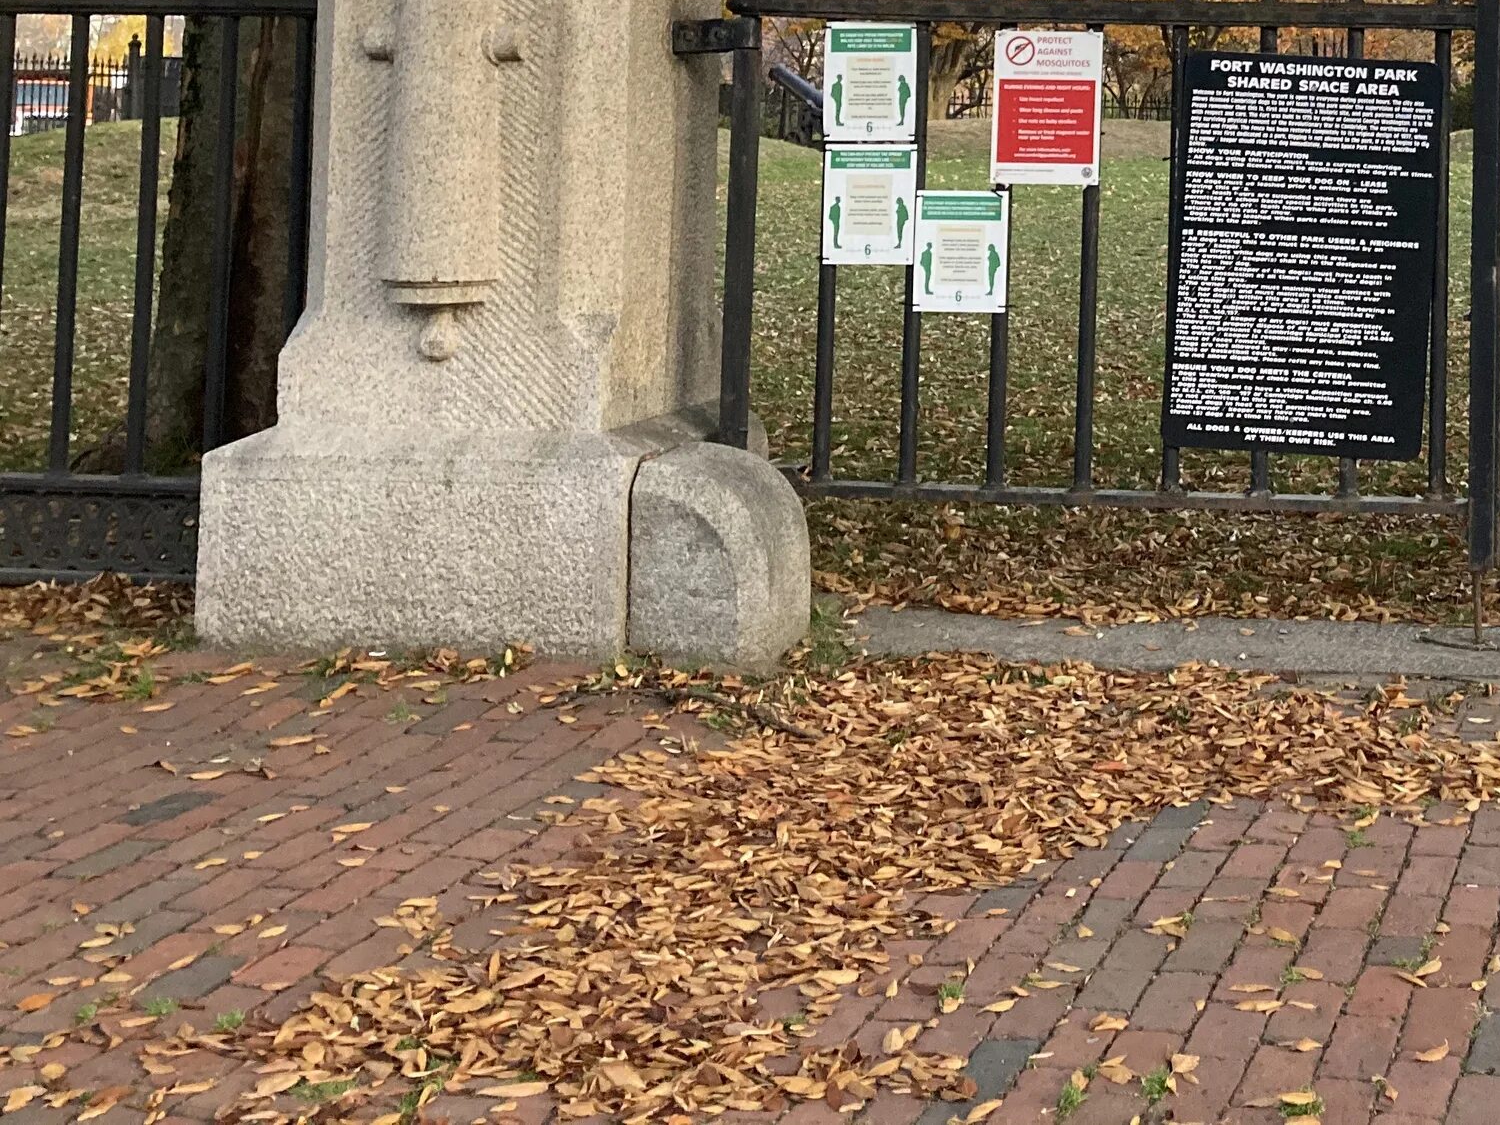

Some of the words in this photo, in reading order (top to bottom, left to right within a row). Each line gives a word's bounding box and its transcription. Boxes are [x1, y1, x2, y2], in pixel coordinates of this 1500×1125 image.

[1211, 60, 1251, 73] FORT
[1259, 62, 1366, 79] WASHINGTON
[1374, 68, 1416, 81] PARK
[1227, 76, 1291, 90] SHARED
[1299, 79, 1348, 93] SPACE
[1356, 82, 1399, 96] AREA
[866, 122, 873, 132] 6
[1244, 150, 1308, 159] PARTICIPATION
[1196, 230, 1250, 239] RESPECTFUL
[1369, 239, 1419, 248] NEIGHBORS
[864, 244, 871, 255] 6
[955, 290, 962, 302] 6
[1312, 371, 1352, 379] CRITERIA
[1205, 425, 1229, 433] DOGS
[1243, 427, 1324, 439] OWNERS/KEEPERS
[1370, 435, 1395, 443] AREA
[1259, 436, 1284, 444] THEIR
